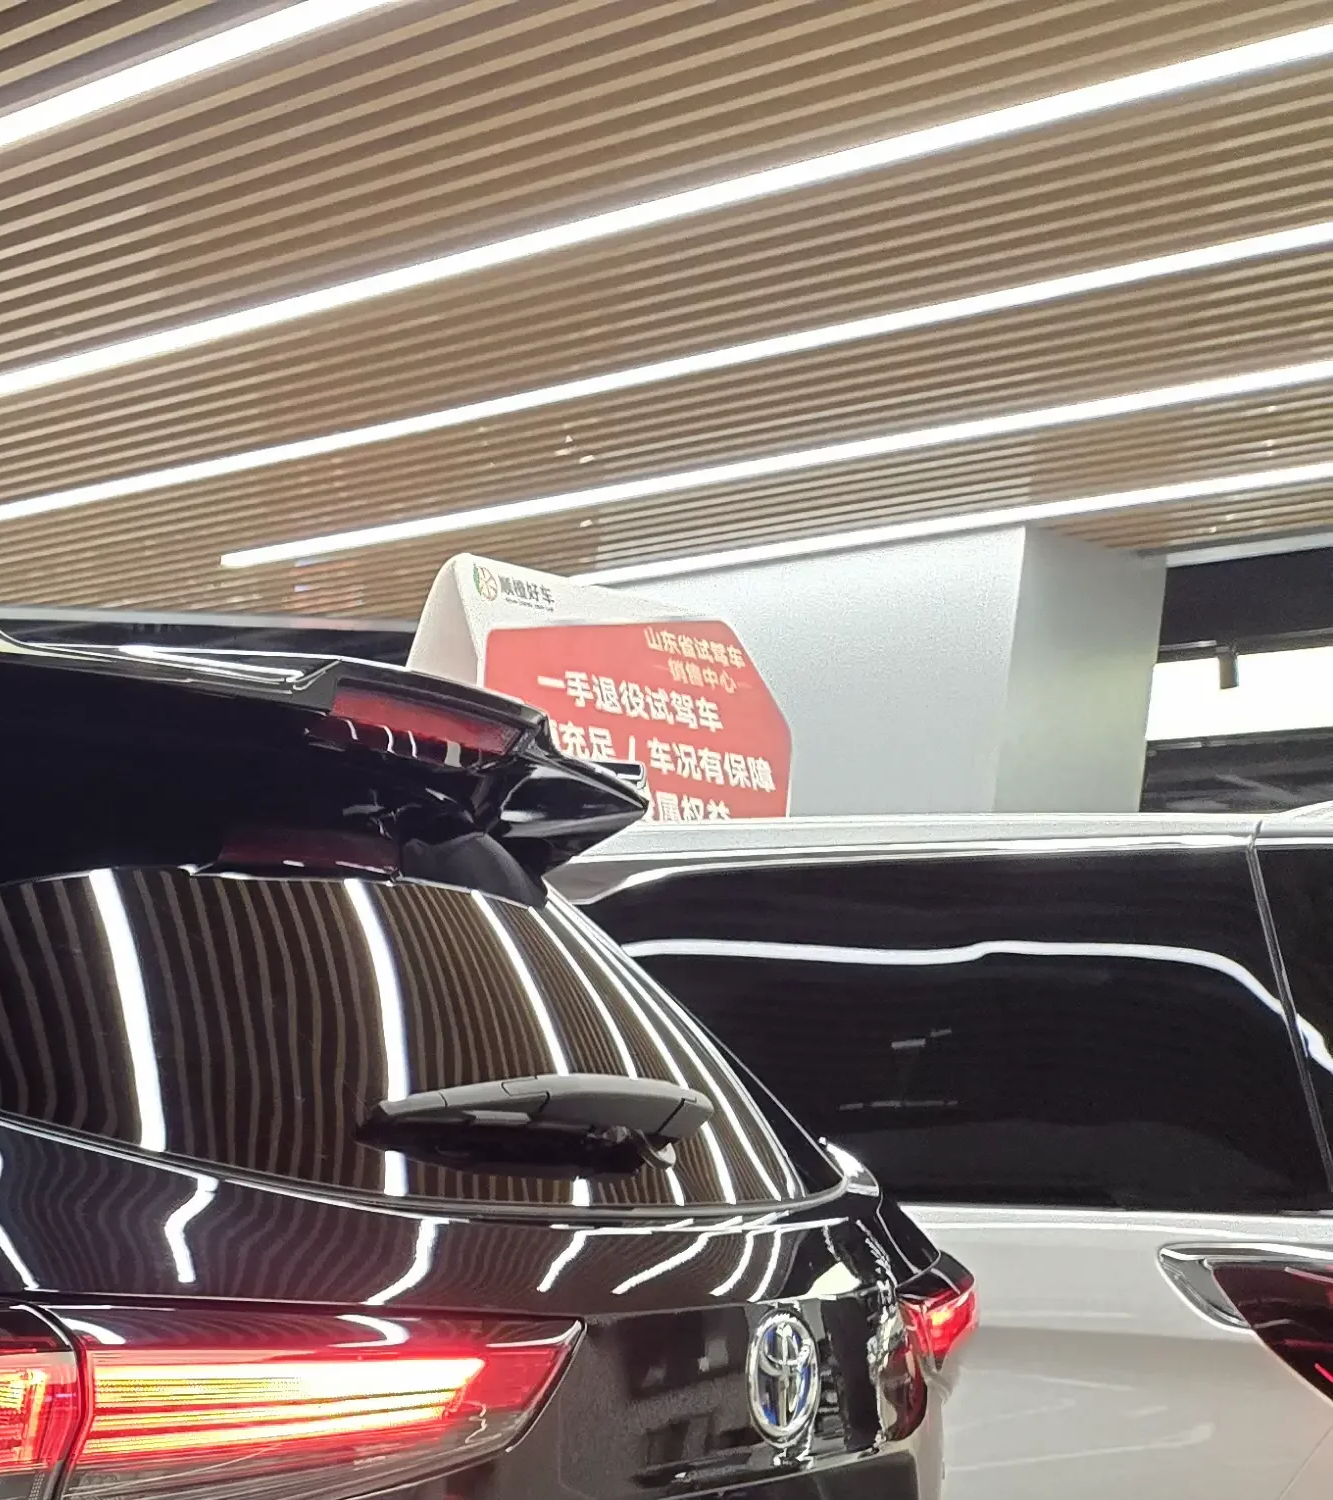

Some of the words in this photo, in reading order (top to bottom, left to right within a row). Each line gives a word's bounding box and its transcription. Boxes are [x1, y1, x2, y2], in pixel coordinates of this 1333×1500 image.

[644, 626, 746, 669] 山东省试驾车
[537, 671, 723, 732] 一手退役试驾车
[667, 657, 737, 694] 销售中心
[549, 719, 617, 761] 充足
[647, 737, 776, 793] 车况有保障
